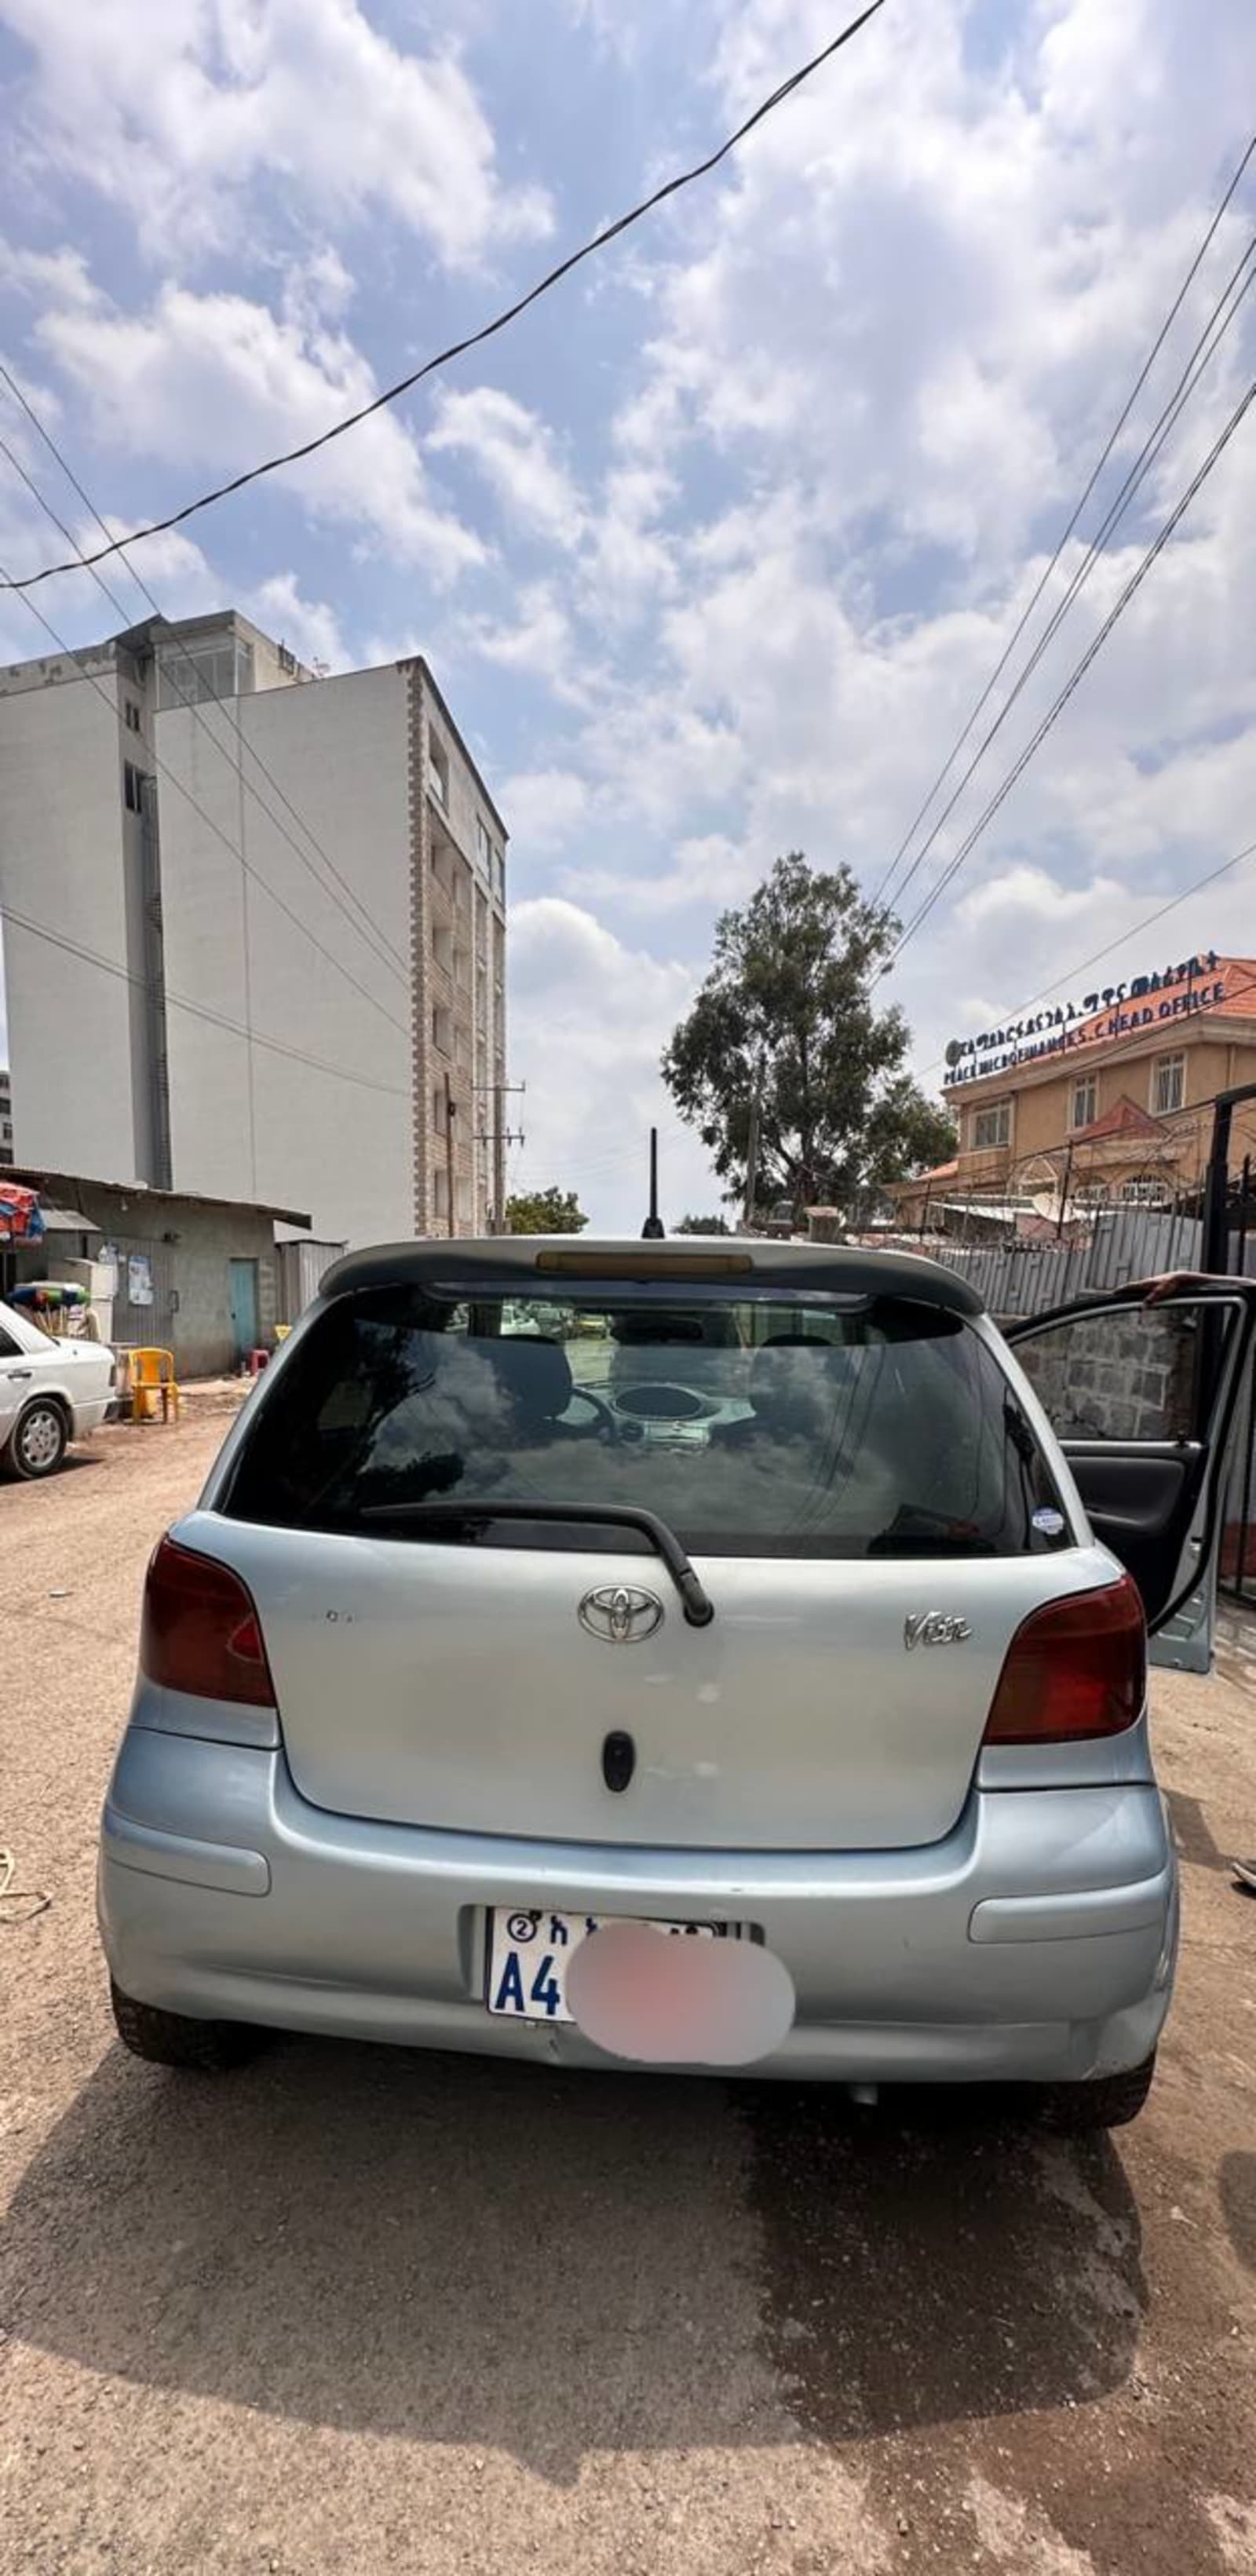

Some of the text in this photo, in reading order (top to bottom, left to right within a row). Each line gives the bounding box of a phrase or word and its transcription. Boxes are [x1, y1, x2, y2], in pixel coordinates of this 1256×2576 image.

[944, 1064, 976, 1085] PEACE
[1108, 1008, 1153, 1034] HEAD
[1159, 981, 1223, 1019] OFFICE
